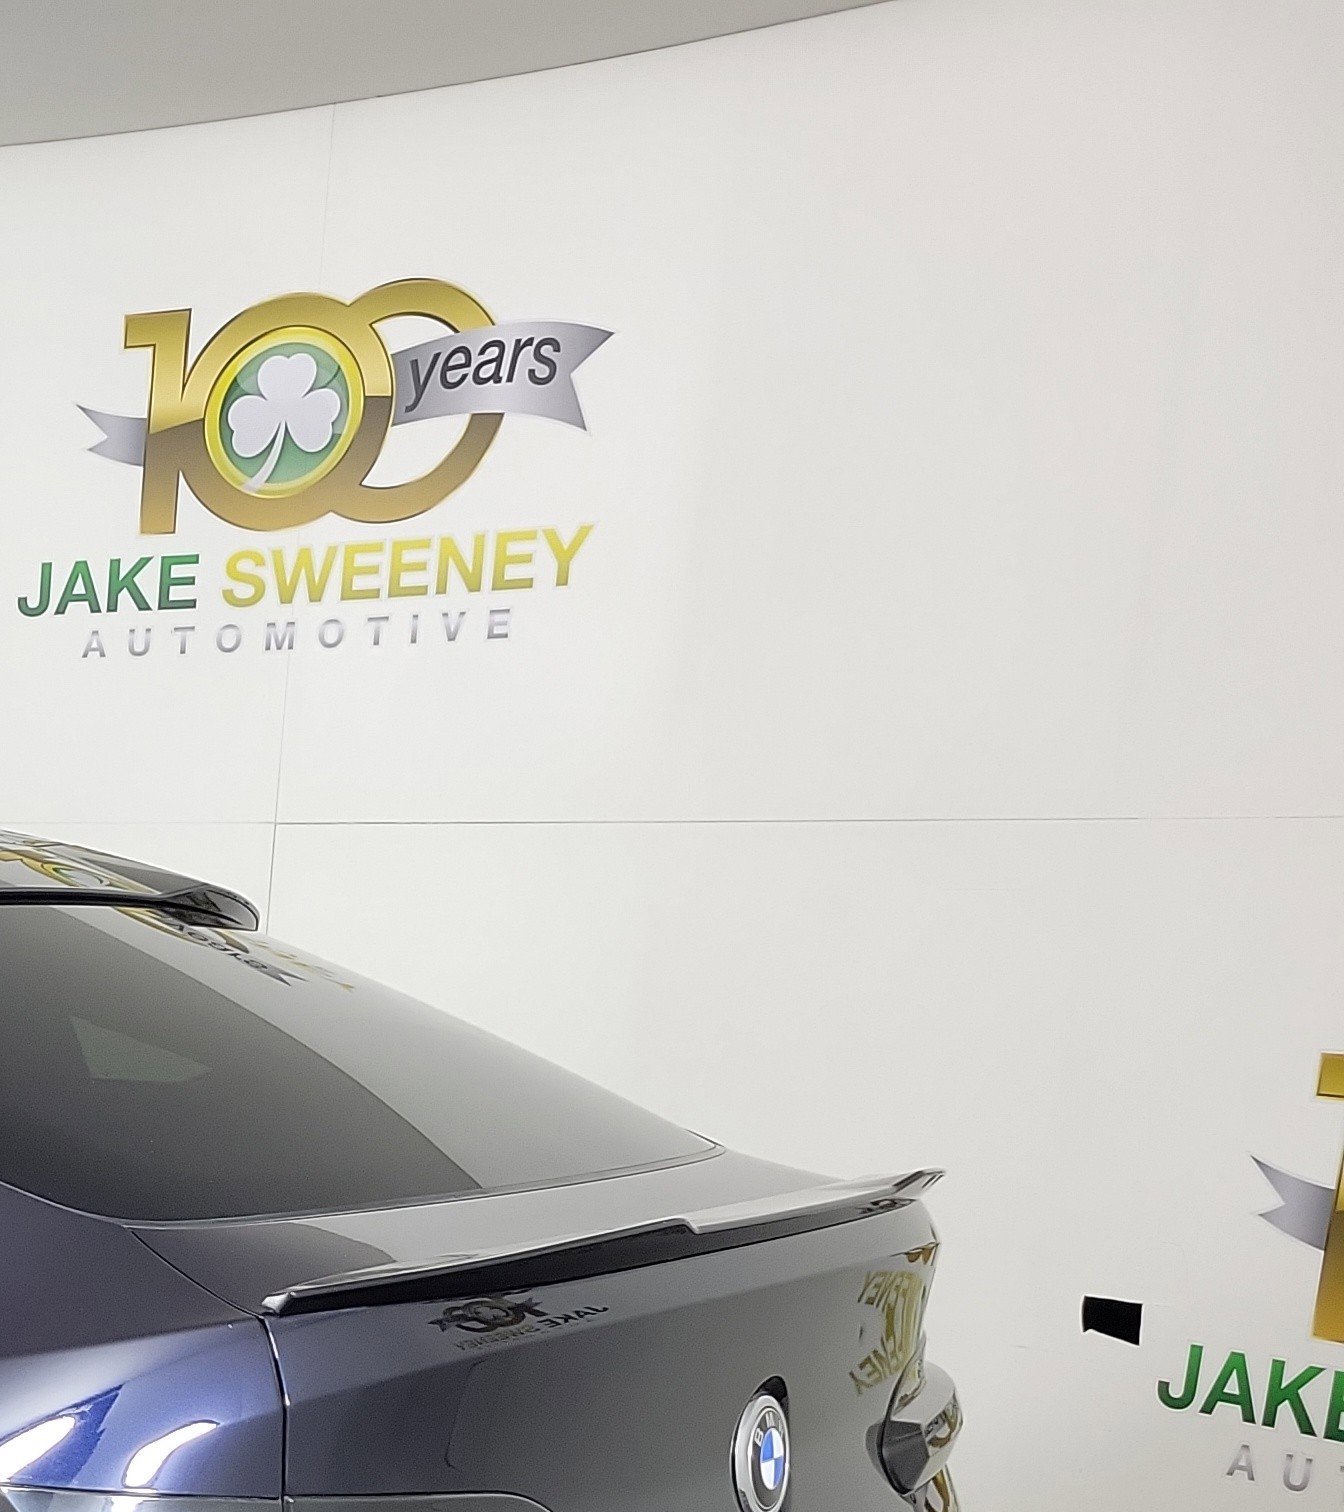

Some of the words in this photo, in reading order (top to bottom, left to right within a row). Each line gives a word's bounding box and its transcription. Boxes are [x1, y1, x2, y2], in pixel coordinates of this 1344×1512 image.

[124, 277, 505, 534] 100
[403, 334, 562, 414] years
[17, 554, 201, 618] JAKE
[221, 525, 594, 608] SWEENEY
[81, 608, 511, 659] AUTOMOTIVE
